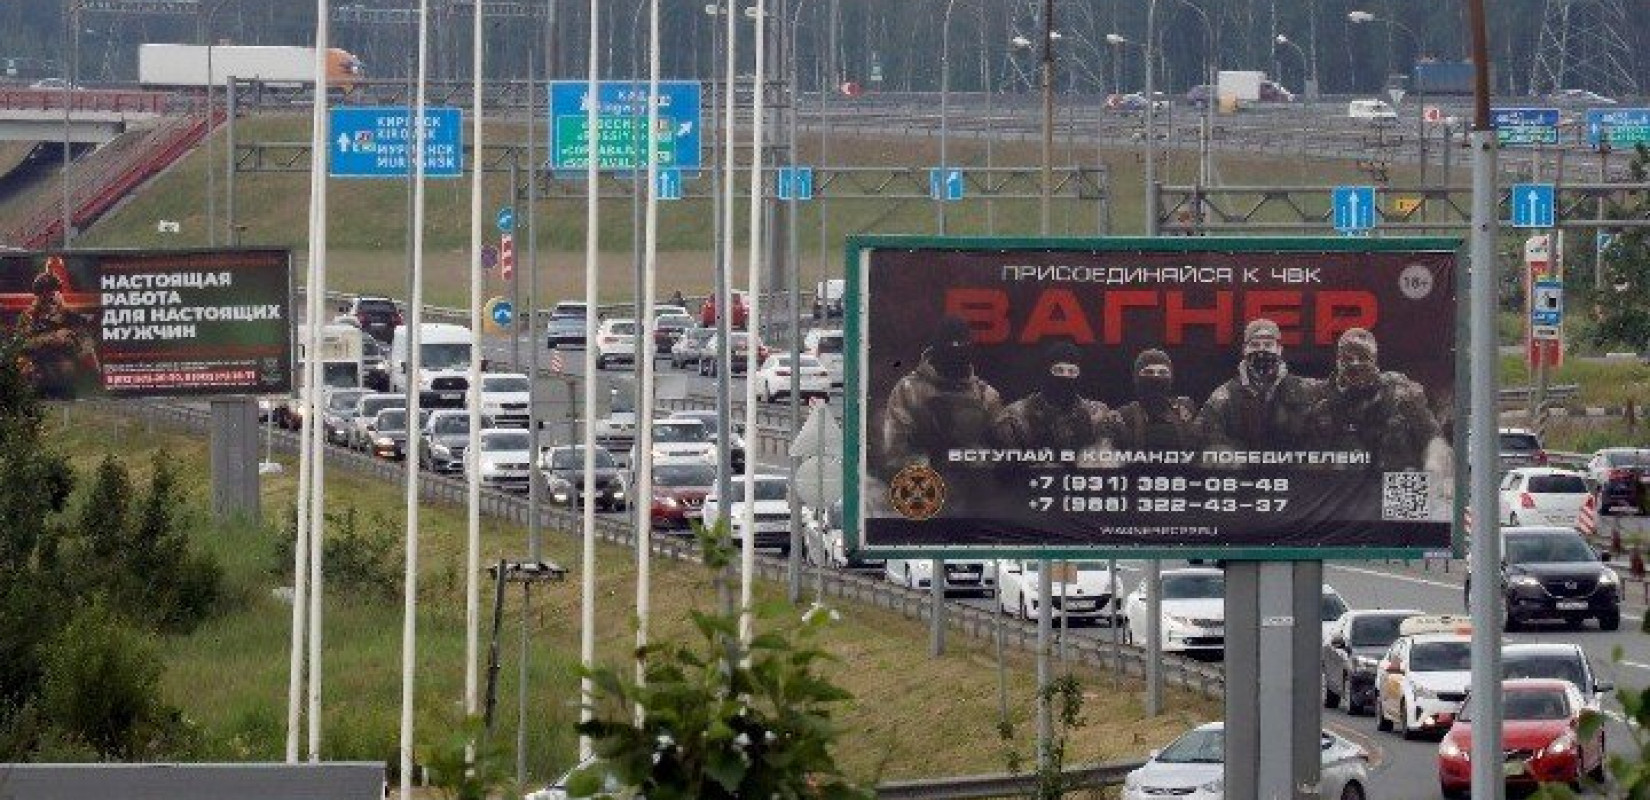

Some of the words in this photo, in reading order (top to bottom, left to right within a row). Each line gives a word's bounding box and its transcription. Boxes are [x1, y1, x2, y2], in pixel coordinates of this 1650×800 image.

[377, 156, 455, 169] MURNSK
[101, 272, 232, 290] НАСТОЯЩАЯ
[1002, 264, 1233, 285] ПРИСОЕДИНЯЙСЯ
[1243, 268, 1260, 283] К
[1271, 267, 1321, 283] ЧВК
[1404, 276, 1428, 290] 18+
[101, 290, 182, 306] РАБОТА
[102, 308, 146, 326] ДЛЯ
[150, 304, 281, 322] НАСТОЯЩИХ
[945, 288, 1379, 345] ВАГНЕР
[102, 324, 196, 340] МУЖЧИН
[948, 447, 1054, 462] ВСТУПАЙ
[1060, 450, 1076, 462] В
[1083, 449, 1196, 464] КОМАНДУ
[1202, 449, 1372, 464] ПОБЕДИТЕЛЕЙ!
[1029, 476, 1055, 489] +7
[1029, 496, 1055, 511] +7
[1138, 497, 1289, 512] 322-43-37
